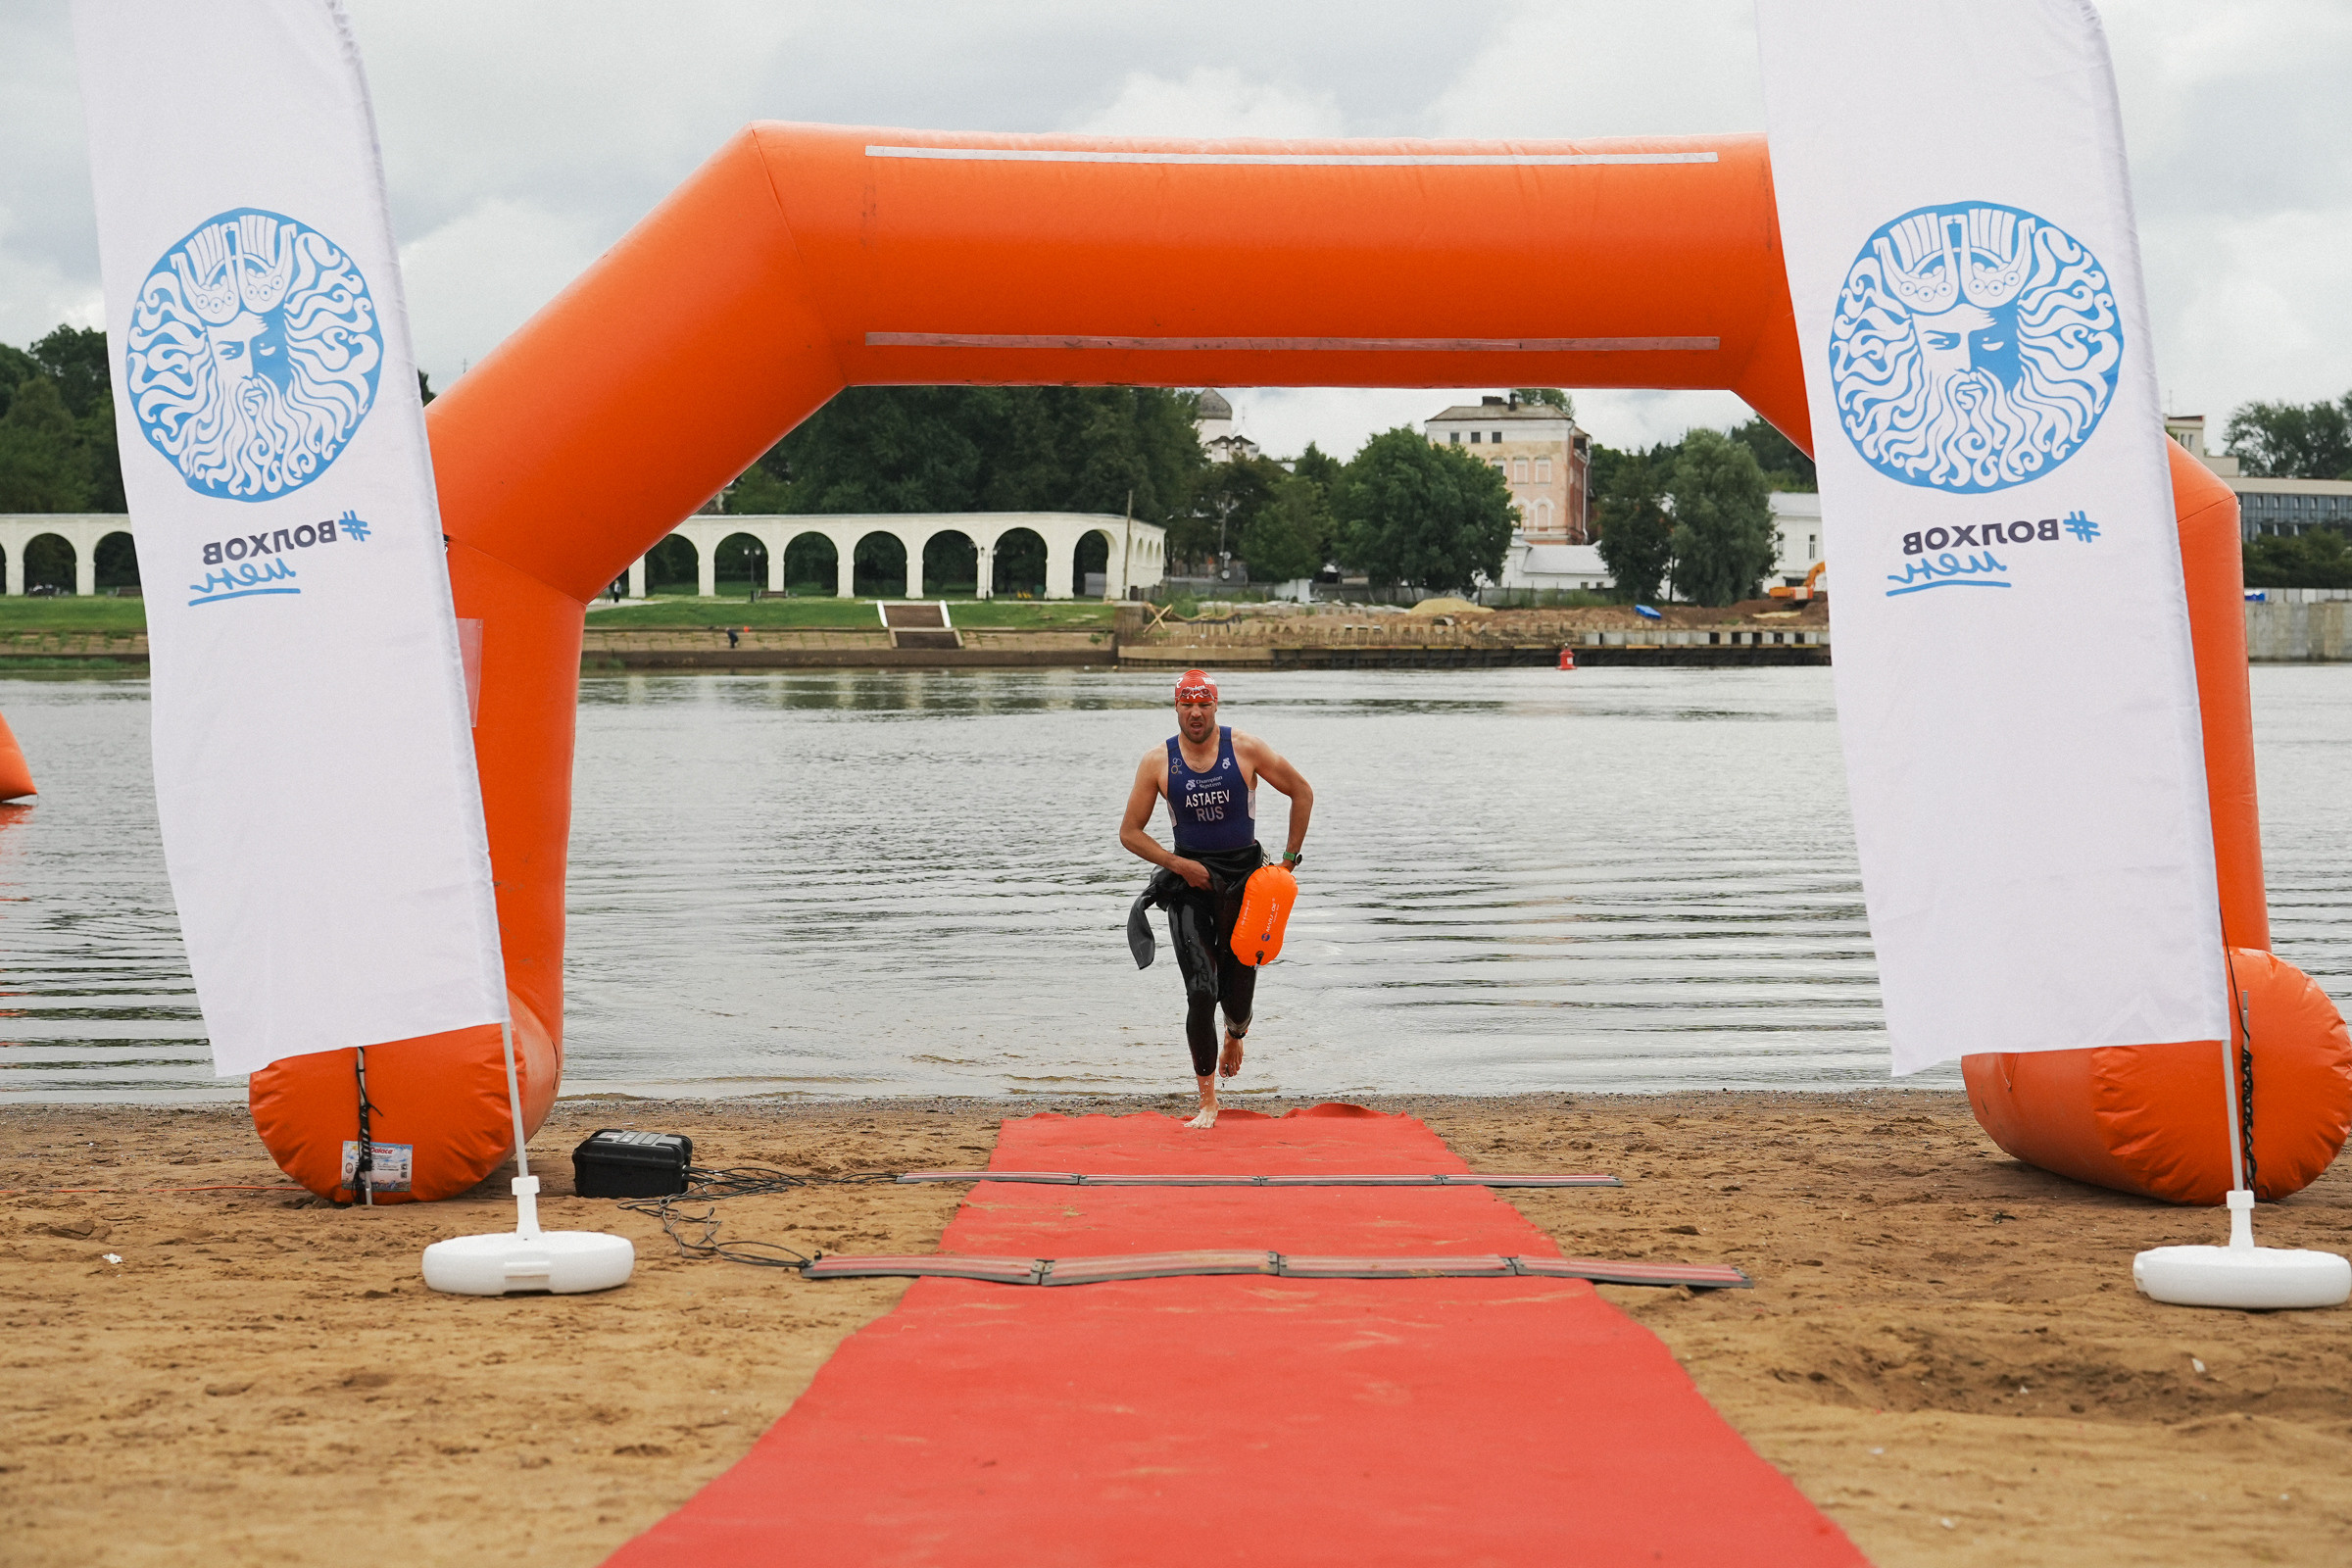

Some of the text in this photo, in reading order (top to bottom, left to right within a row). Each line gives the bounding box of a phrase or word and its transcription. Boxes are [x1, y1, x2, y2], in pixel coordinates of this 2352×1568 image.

[1196, 775, 1223, 785] Champion
[1199, 781, 1222, 790] System
[1185, 789, 1230, 808] ASTAFEV
[1196, 806, 1225, 822] RUS
